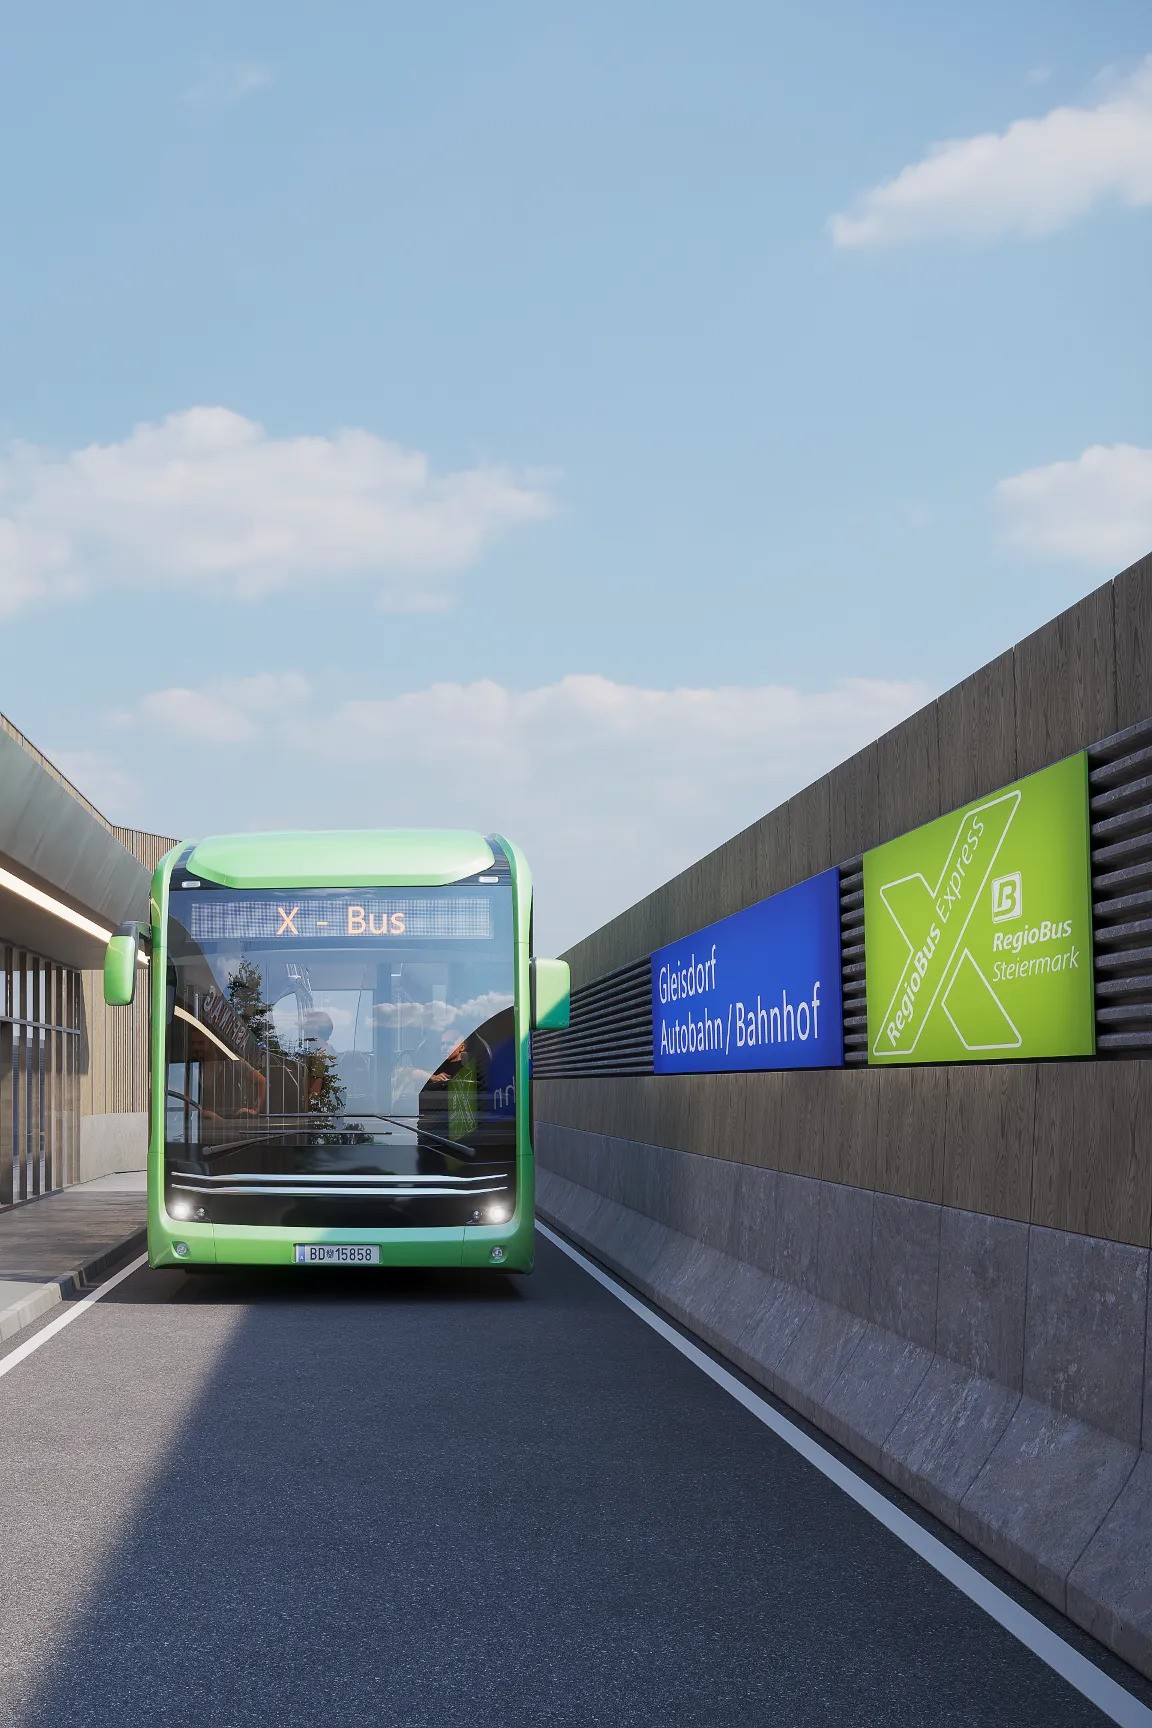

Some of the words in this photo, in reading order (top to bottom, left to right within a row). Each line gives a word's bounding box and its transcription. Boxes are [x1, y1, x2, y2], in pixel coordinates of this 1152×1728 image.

[276, 906, 299, 935] X
[347, 905, 405, 935] Bus
[886, 923, 941, 1047] RegioBus
[935, 815, 984, 924] Express
[992, 919, 1072, 954] RegioBus
[659, 944, 717, 1004] Gleisdorf
[992, 945, 1079, 982] Steiermark
[310, 1247, 325, 1261] BD
[335, 1247, 372, 1261] 15858
